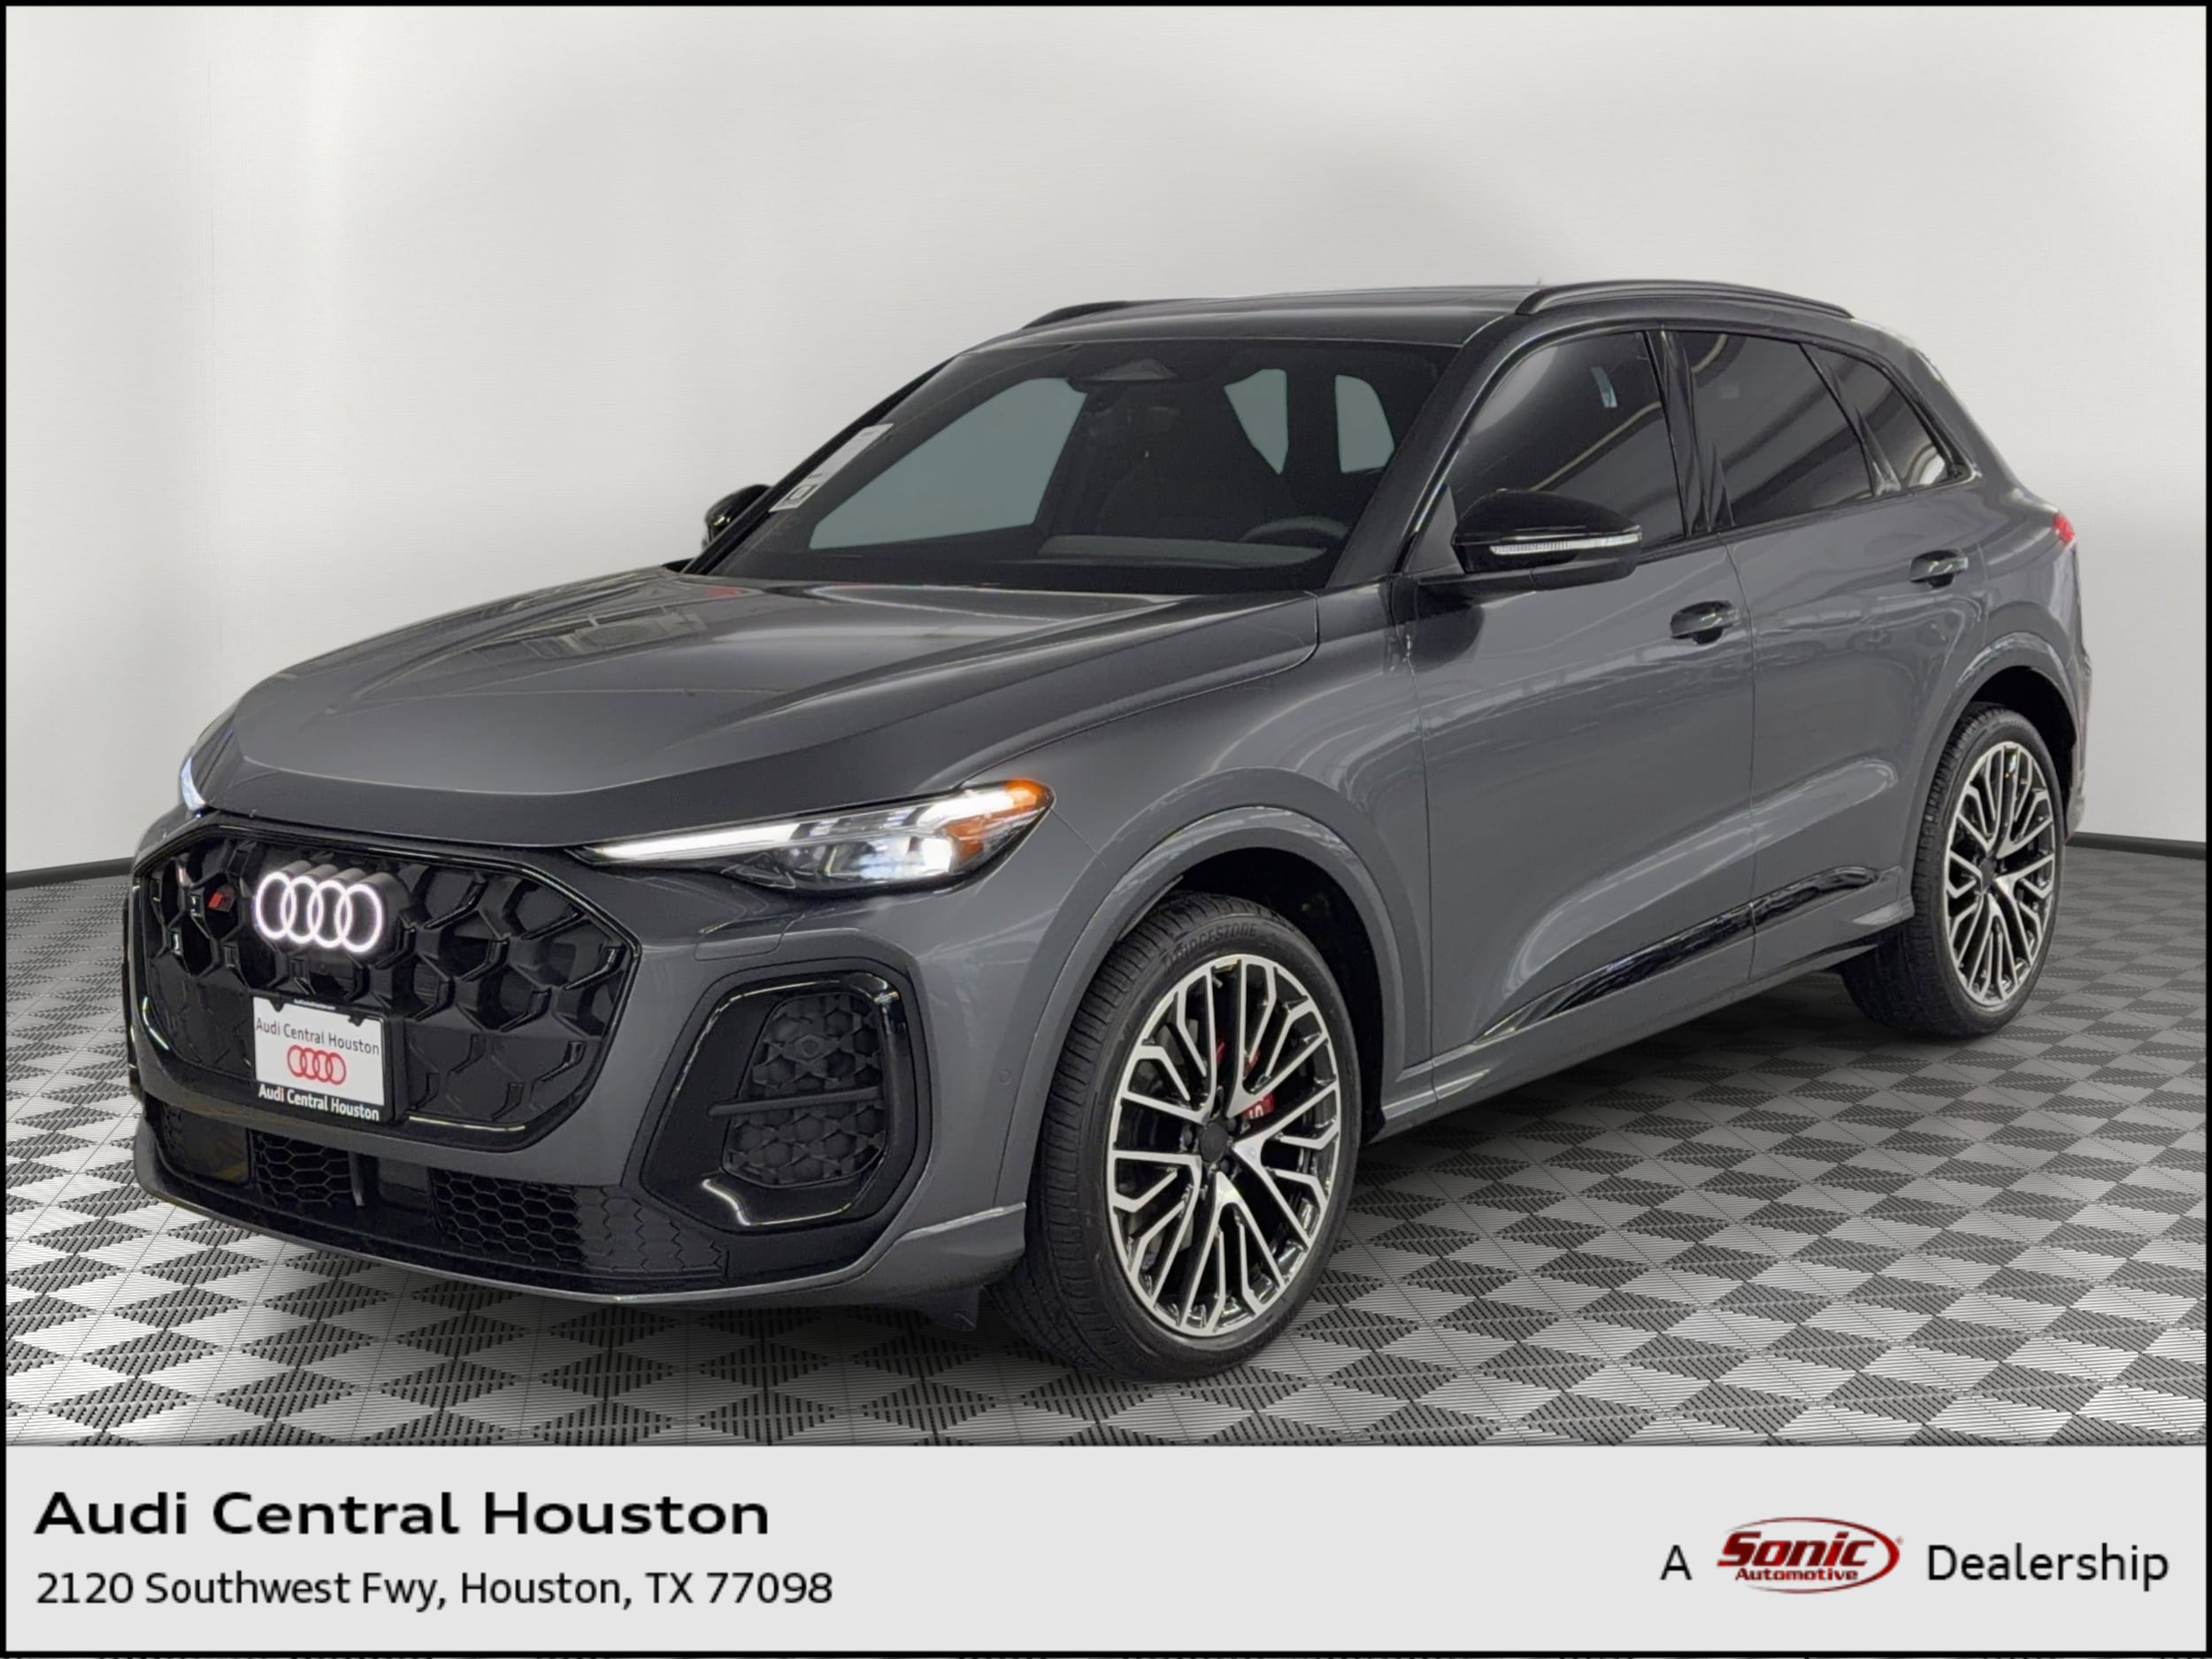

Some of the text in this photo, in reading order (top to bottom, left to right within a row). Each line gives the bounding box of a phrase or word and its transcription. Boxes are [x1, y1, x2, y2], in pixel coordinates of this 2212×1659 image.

[1164, 922, 1257, 971] IDGESTONE
[256, 1018, 380, 1055] Audi Central Houston
[258, 1083, 380, 1121] Audi Central Houston
